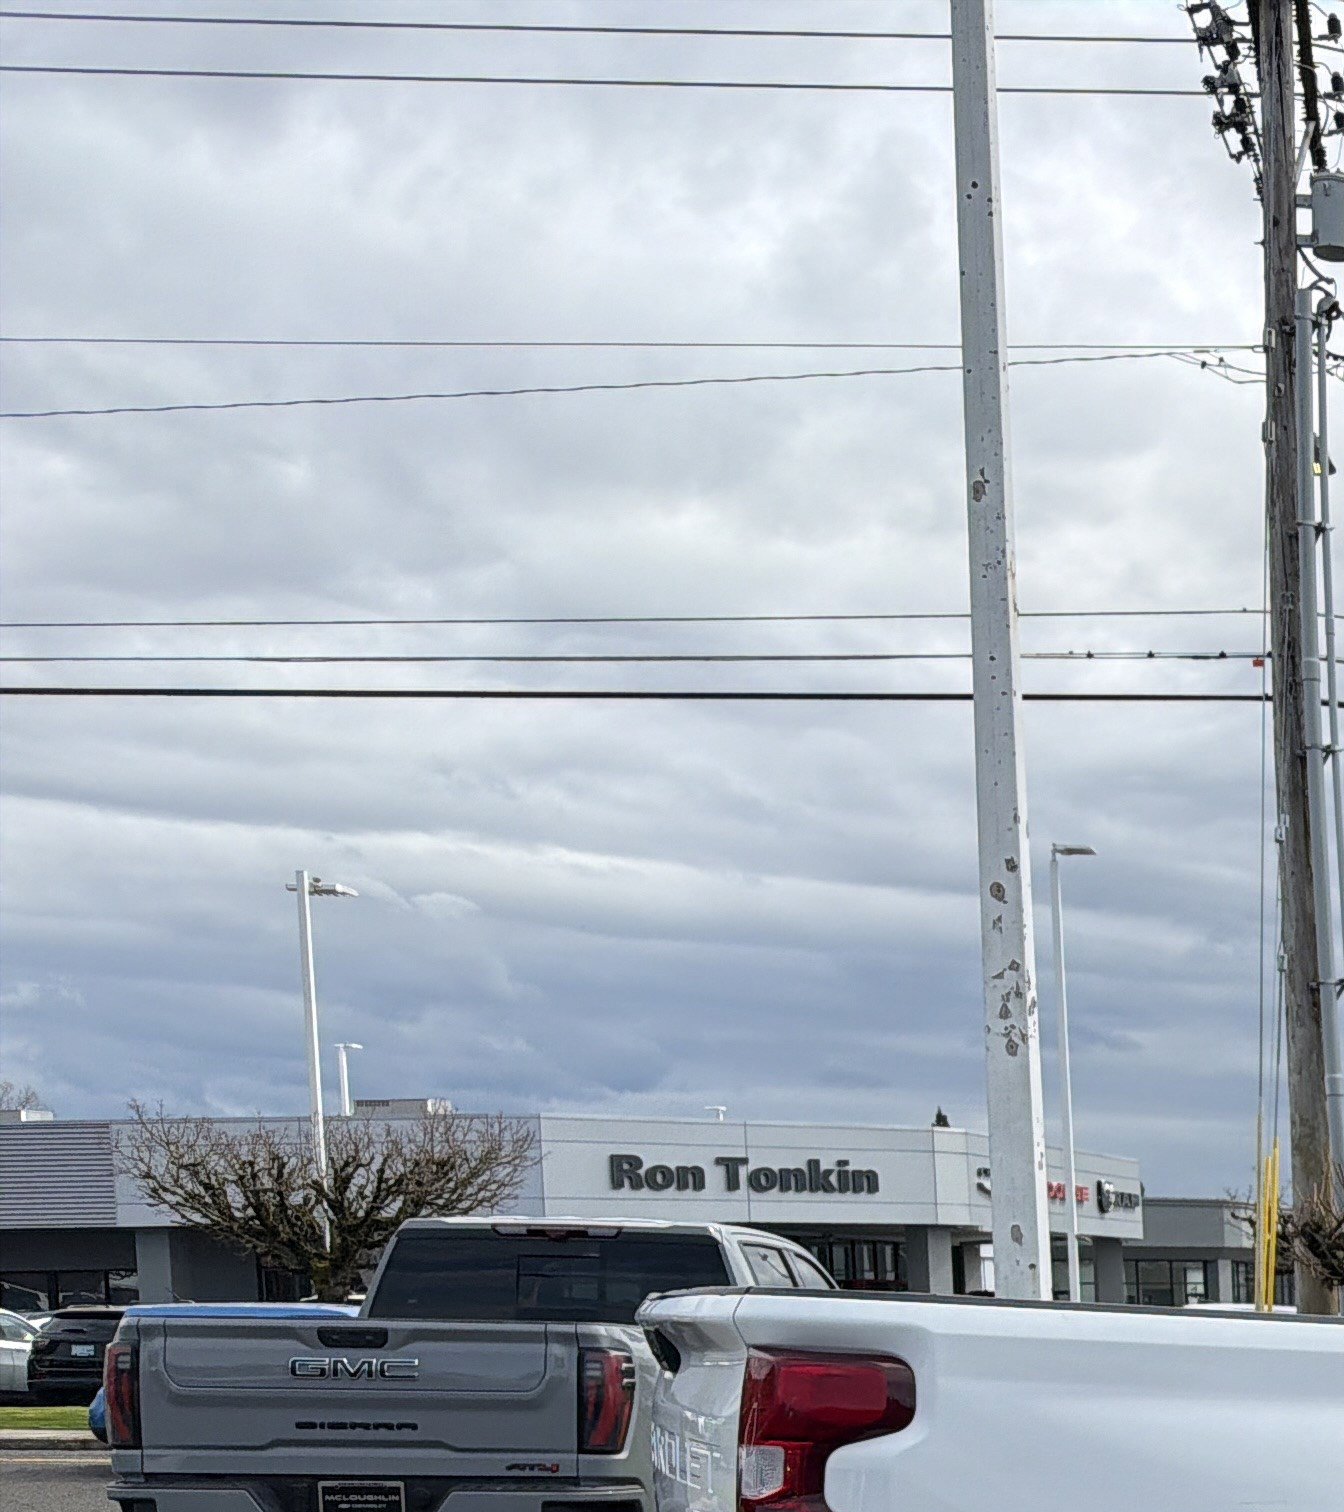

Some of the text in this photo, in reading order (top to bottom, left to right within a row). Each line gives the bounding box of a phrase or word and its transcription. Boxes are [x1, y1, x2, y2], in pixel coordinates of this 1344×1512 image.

[609, 1153, 880, 1195] Ron Tonkin
[288, 1356, 420, 1381] GMC
[294, 1420, 419, 1431] SIERRA
